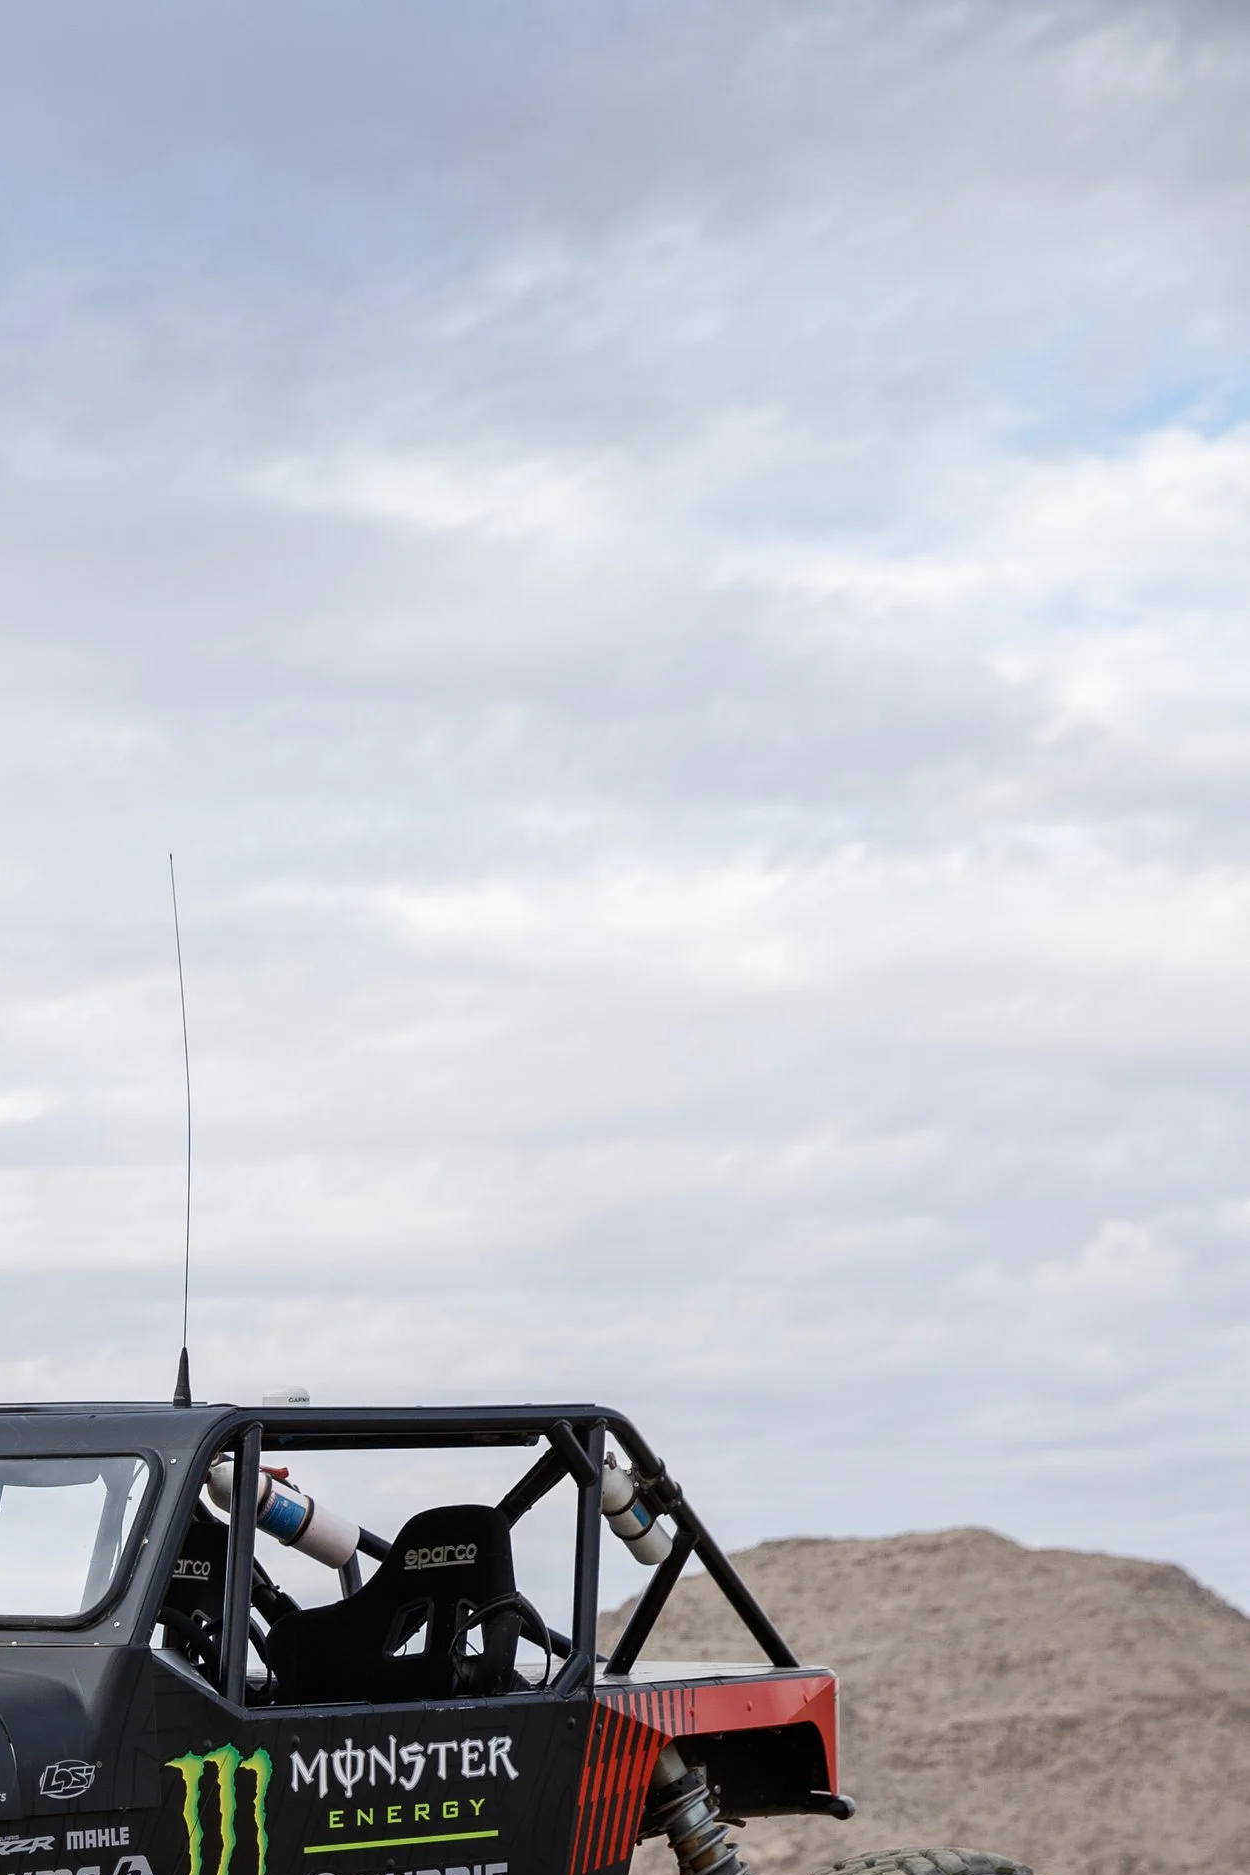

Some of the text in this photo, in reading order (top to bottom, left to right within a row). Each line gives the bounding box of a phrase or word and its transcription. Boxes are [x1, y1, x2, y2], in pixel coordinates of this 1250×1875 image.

[173, 1559, 211, 1576] arco
[404, 1543, 478, 1570] sparco
[289, 1734, 519, 1799] MONSTER
[329, 1798, 485, 1829] ENERGY
[66, 1826, 130, 1850] MAHLE
